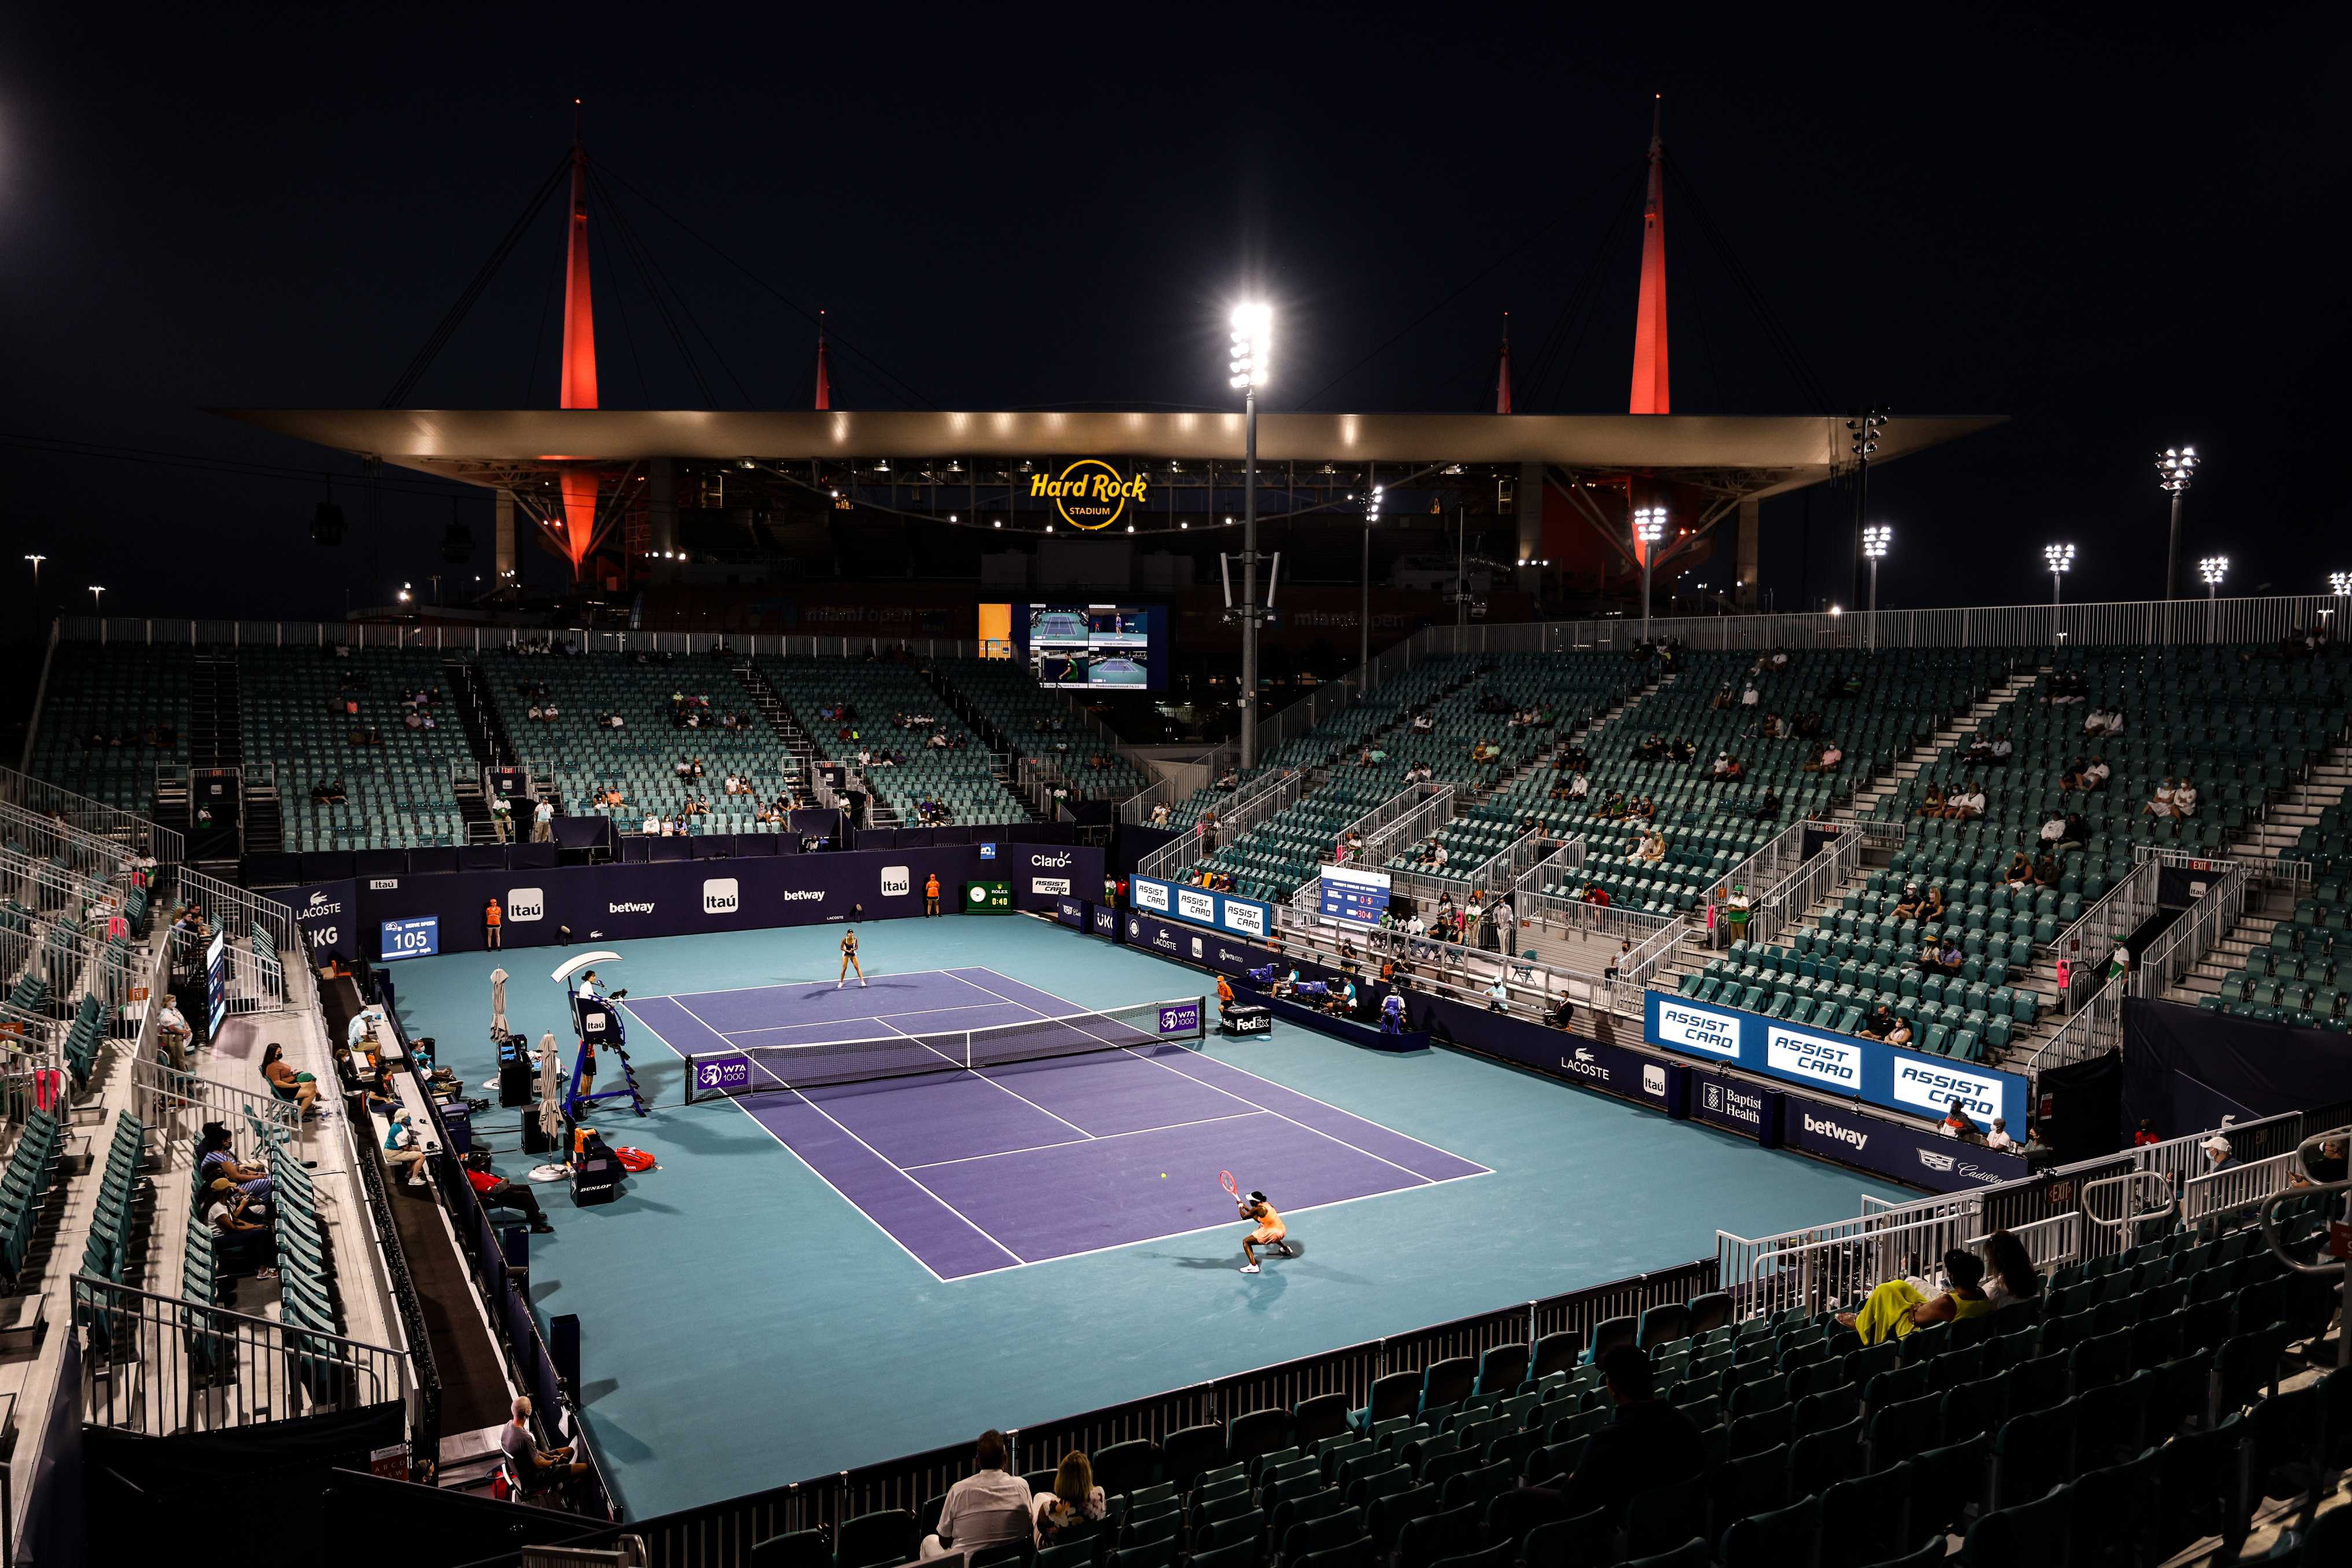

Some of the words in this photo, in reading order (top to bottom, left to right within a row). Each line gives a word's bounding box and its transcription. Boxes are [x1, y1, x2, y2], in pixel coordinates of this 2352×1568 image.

[1030, 474, 1089, 496] Hard
[1092, 474, 1147, 502] Rock
[1031, 855, 1066, 867] Claro
[2193, 861, 2207, 870] EXIT
[376, 880, 394, 888] Itaú
[883, 880, 907, 892] Itaú
[784, 890, 825, 901] betway
[1139, 885, 1164, 896] ASSIST
[706, 895, 736, 908] Itaú
[1147, 896, 1166, 906] CARD
[1181, 895, 1209, 907] ASSIST
[296, 903, 341, 920] LACOSTE
[511, 904, 541, 916] Itaú
[609, 902, 655, 914] betway
[1190, 906, 1211, 917] CARD
[1228, 906, 1258, 918] ASSIST
[1237, 918, 1260, 929] CARD
[394, 931, 427, 949] 105
[1153, 936, 1176, 951] LACOSTE
[1192, 945, 1202, 955] Itaú
[1178, 1010, 1195, 1018] WTA
[1223, 1018, 1235, 1028] FedEx
[1236, 1016, 1269, 1030] FedEx
[1665, 1010, 1729, 1033] ASSIST
[1685, 1029, 1733, 1049] CARD
[1775, 1036, 1849, 1062] ASSIST
[723, 1065, 746, 1073] WTA
[1561, 1057, 1609, 1080] LACOSTE
[1797, 1057, 1853, 1079] CARD
[723, 1073, 745, 1081] 1000
[1902, 1067, 1989, 1096] ASSIST
[1645, 1081, 1663, 1092] Itaú
[1727, 1089, 1761, 1110] Baptist
[1928, 1089, 1993, 1115] CARD
[1727, 1103, 1760, 1124] Health
[1804, 1113, 1868, 1150] betway
[580, 1184, 612, 1192] DUNLOP
[2053, 1181, 2070, 1202] EXIT
